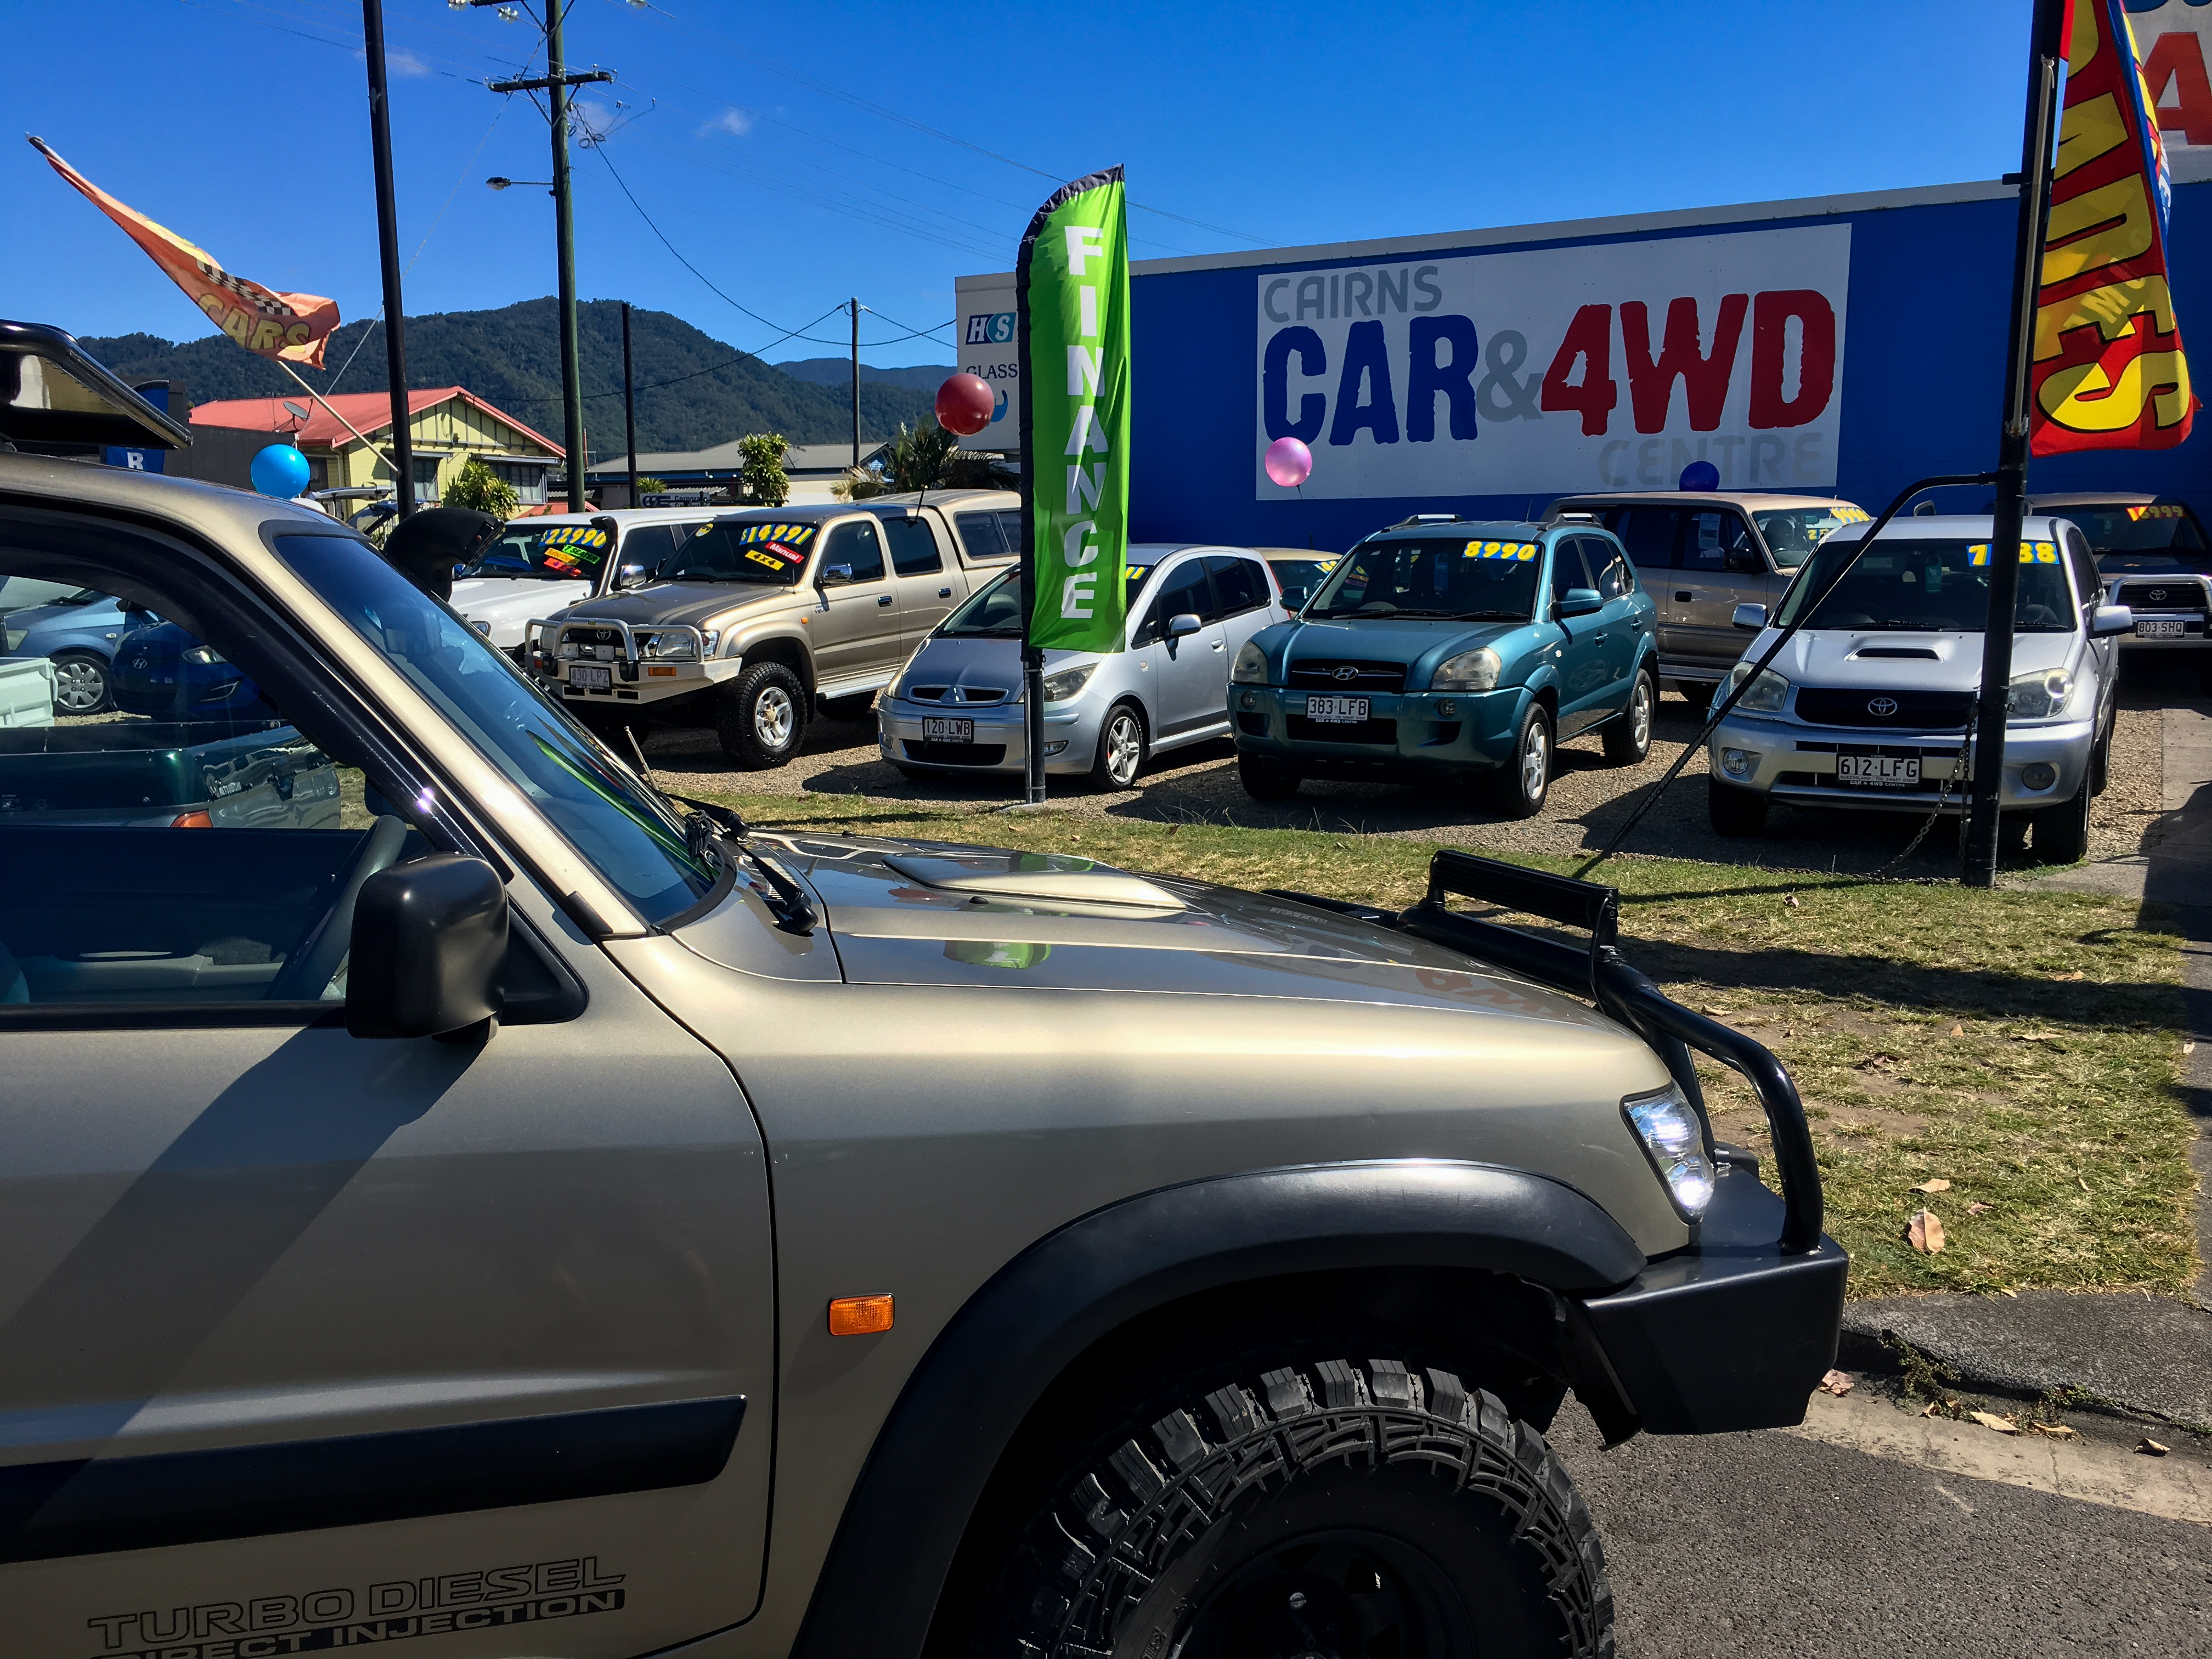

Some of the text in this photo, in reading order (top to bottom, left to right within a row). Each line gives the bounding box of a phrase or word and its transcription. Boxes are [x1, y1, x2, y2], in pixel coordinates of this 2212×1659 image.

[1264, 266, 1442, 323] CAIRNS
[198, 294, 311, 350] CARS
[966, 363, 1018, 379] GLASS
[1263, 289, 1836, 447] CAR & 4WD
[1060, 226, 1109, 618] FINANCE
[1598, 432, 1823, 487] CENTRE
[540, 527, 607, 548] $22990
[741, 524, 812, 545] $14991
[770, 543, 800, 561] Manual
[1464, 541, 1536, 561] 8990
[570, 548, 598, 562] SEATER
[1968, 543, 2056, 565] 788
[87, 1556, 627, 1651] TURBO DIESEL
[332, 1590, 617, 1647] INJECTION
